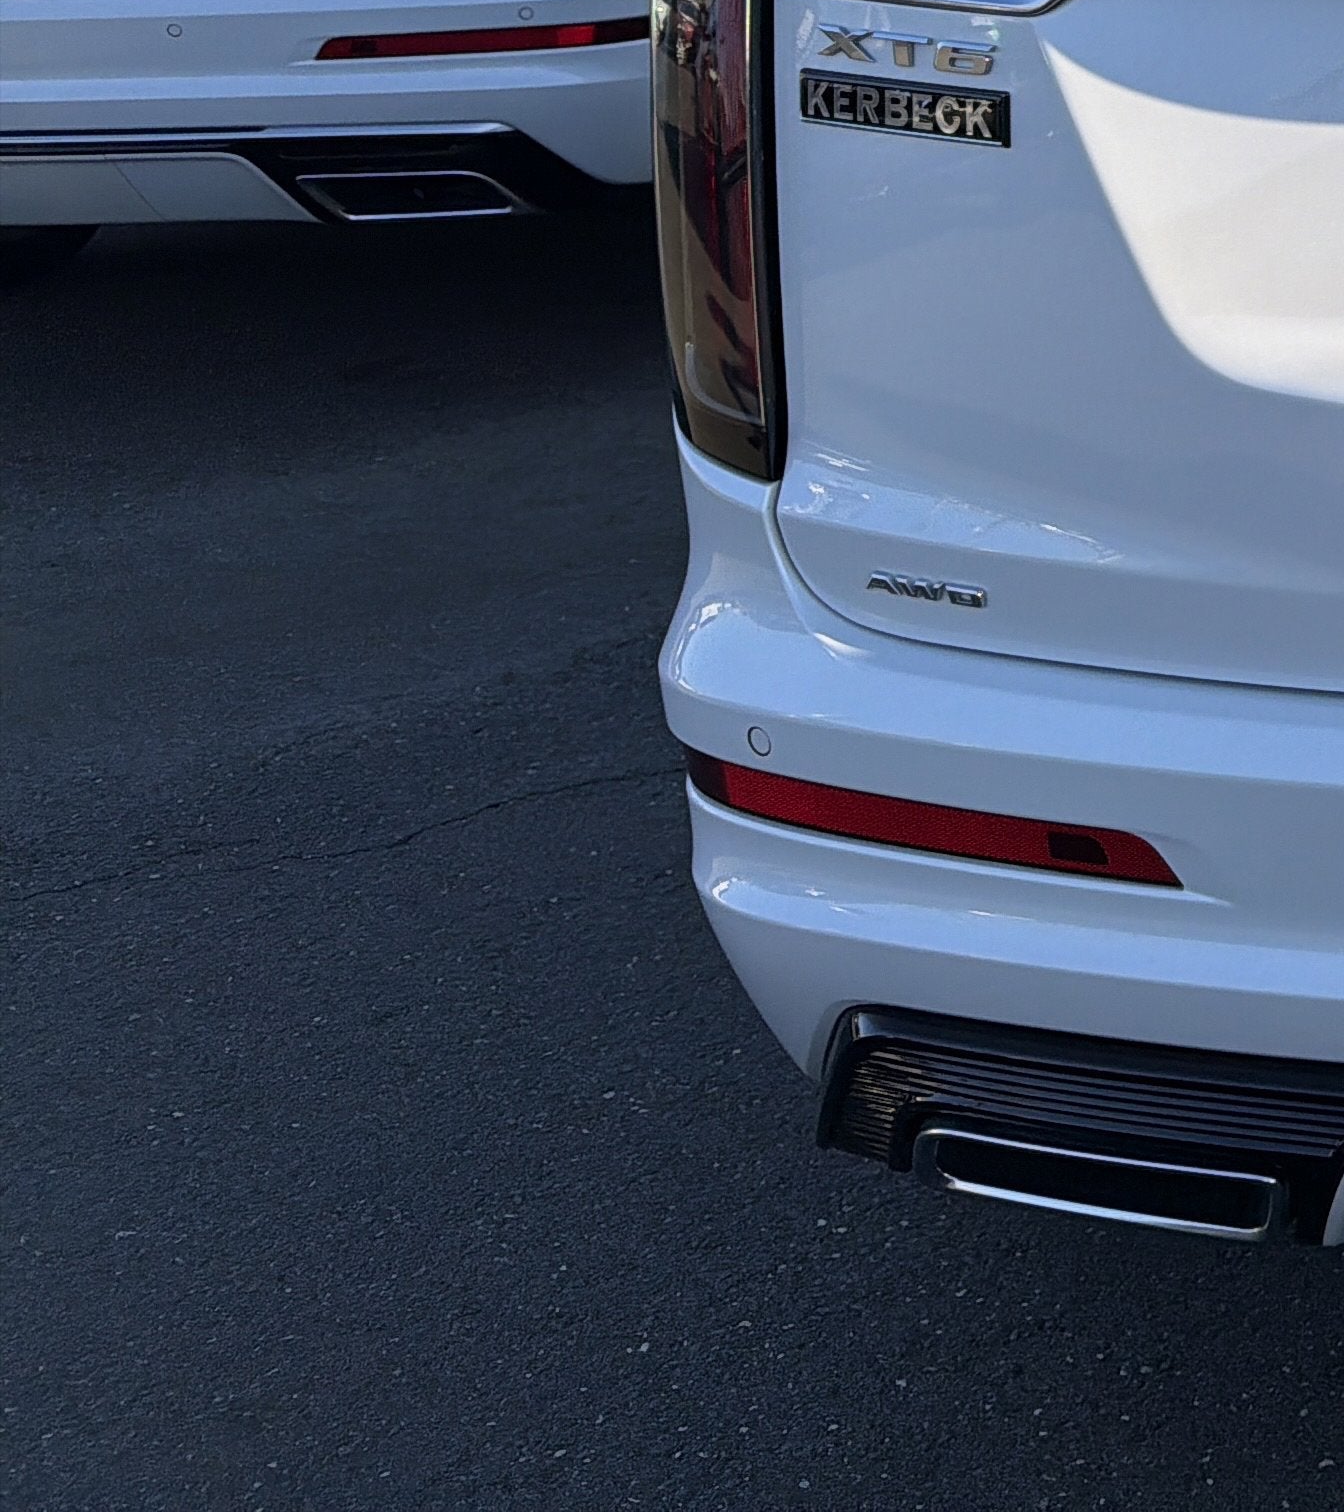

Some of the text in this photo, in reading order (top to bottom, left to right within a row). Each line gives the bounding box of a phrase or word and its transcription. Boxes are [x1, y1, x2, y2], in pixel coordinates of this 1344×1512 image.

[817, 22, 998, 75] XT6
[807, 78, 993, 138] KERBECK
[866, 570, 988, 608] AWD
